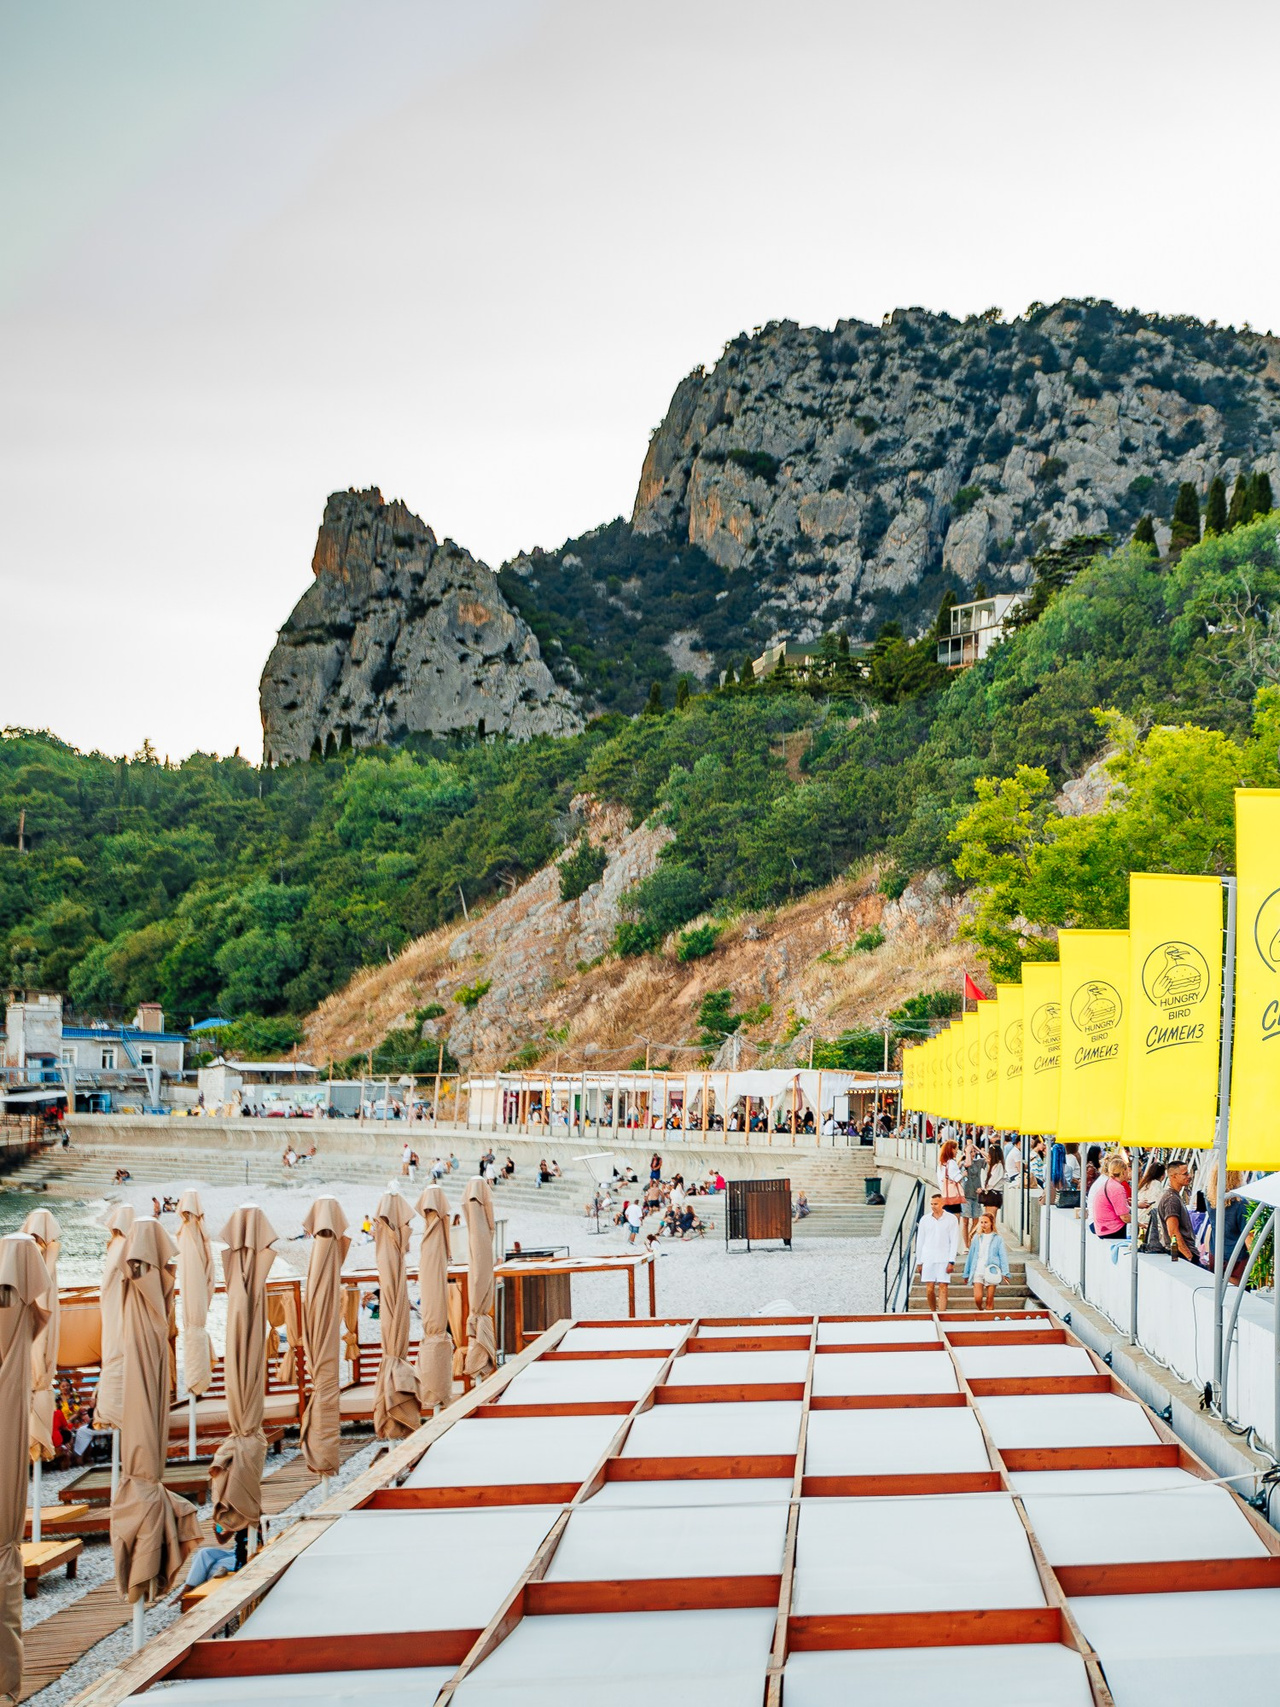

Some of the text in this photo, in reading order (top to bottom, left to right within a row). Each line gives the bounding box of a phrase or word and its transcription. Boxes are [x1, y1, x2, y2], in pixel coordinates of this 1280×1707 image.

[1160, 992, 1200, 1007] HUNGRY
[1168, 1008, 1191, 1020] BIRD
[1084, 1019, 1115, 1032] HUNGRY
[1042, 1036, 1060, 1044] HUNG
[1091, 1032, 1108, 1042] BIRD
[1146, 1024, 1204, 1047] СИМЕИЗ
[1074, 1043, 1119, 1064] СИМЕИЗ
[1034, 1056, 1060, 1070] СИМЕ
